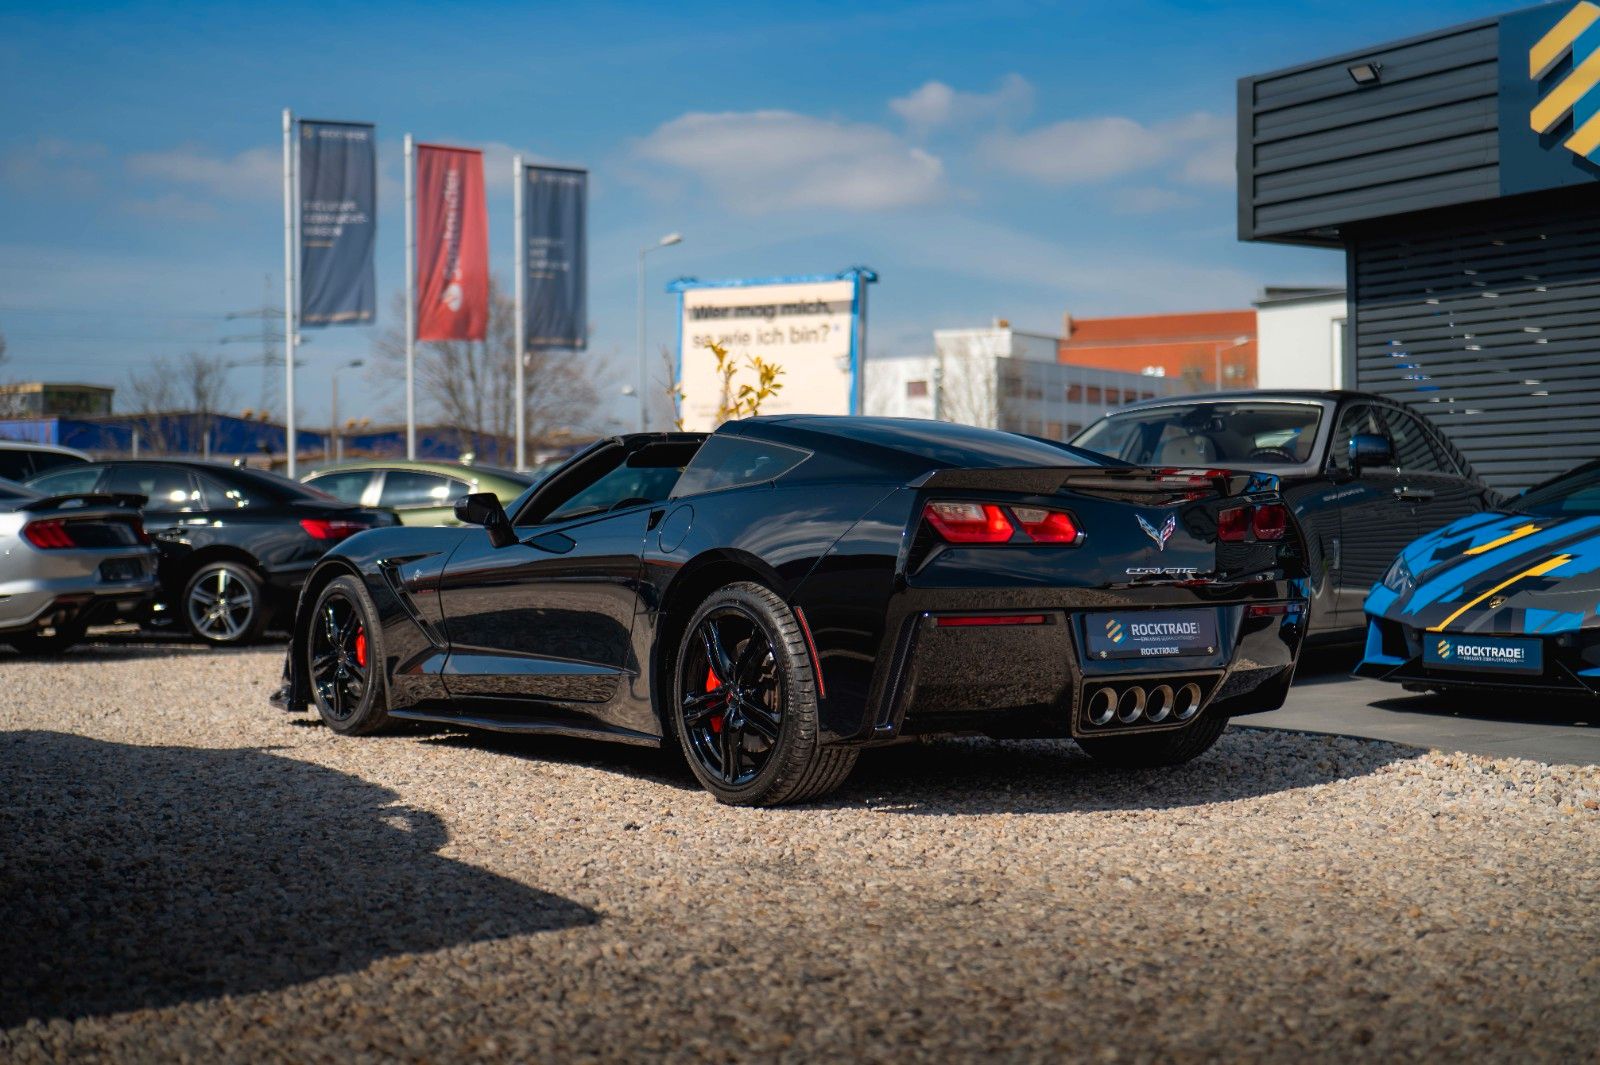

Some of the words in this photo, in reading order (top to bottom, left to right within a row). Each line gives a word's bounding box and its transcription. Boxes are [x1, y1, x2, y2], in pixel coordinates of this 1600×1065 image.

[734, 303, 776, 322] mag
[718, 329, 751, 346] wie
[757, 327, 785, 345] ich
[1131, 623, 1197, 635] ROCKTRADE
[1140, 647, 1179, 655] ROCKTRADE
[1457, 645, 1520, 658] ROCKTRADE
